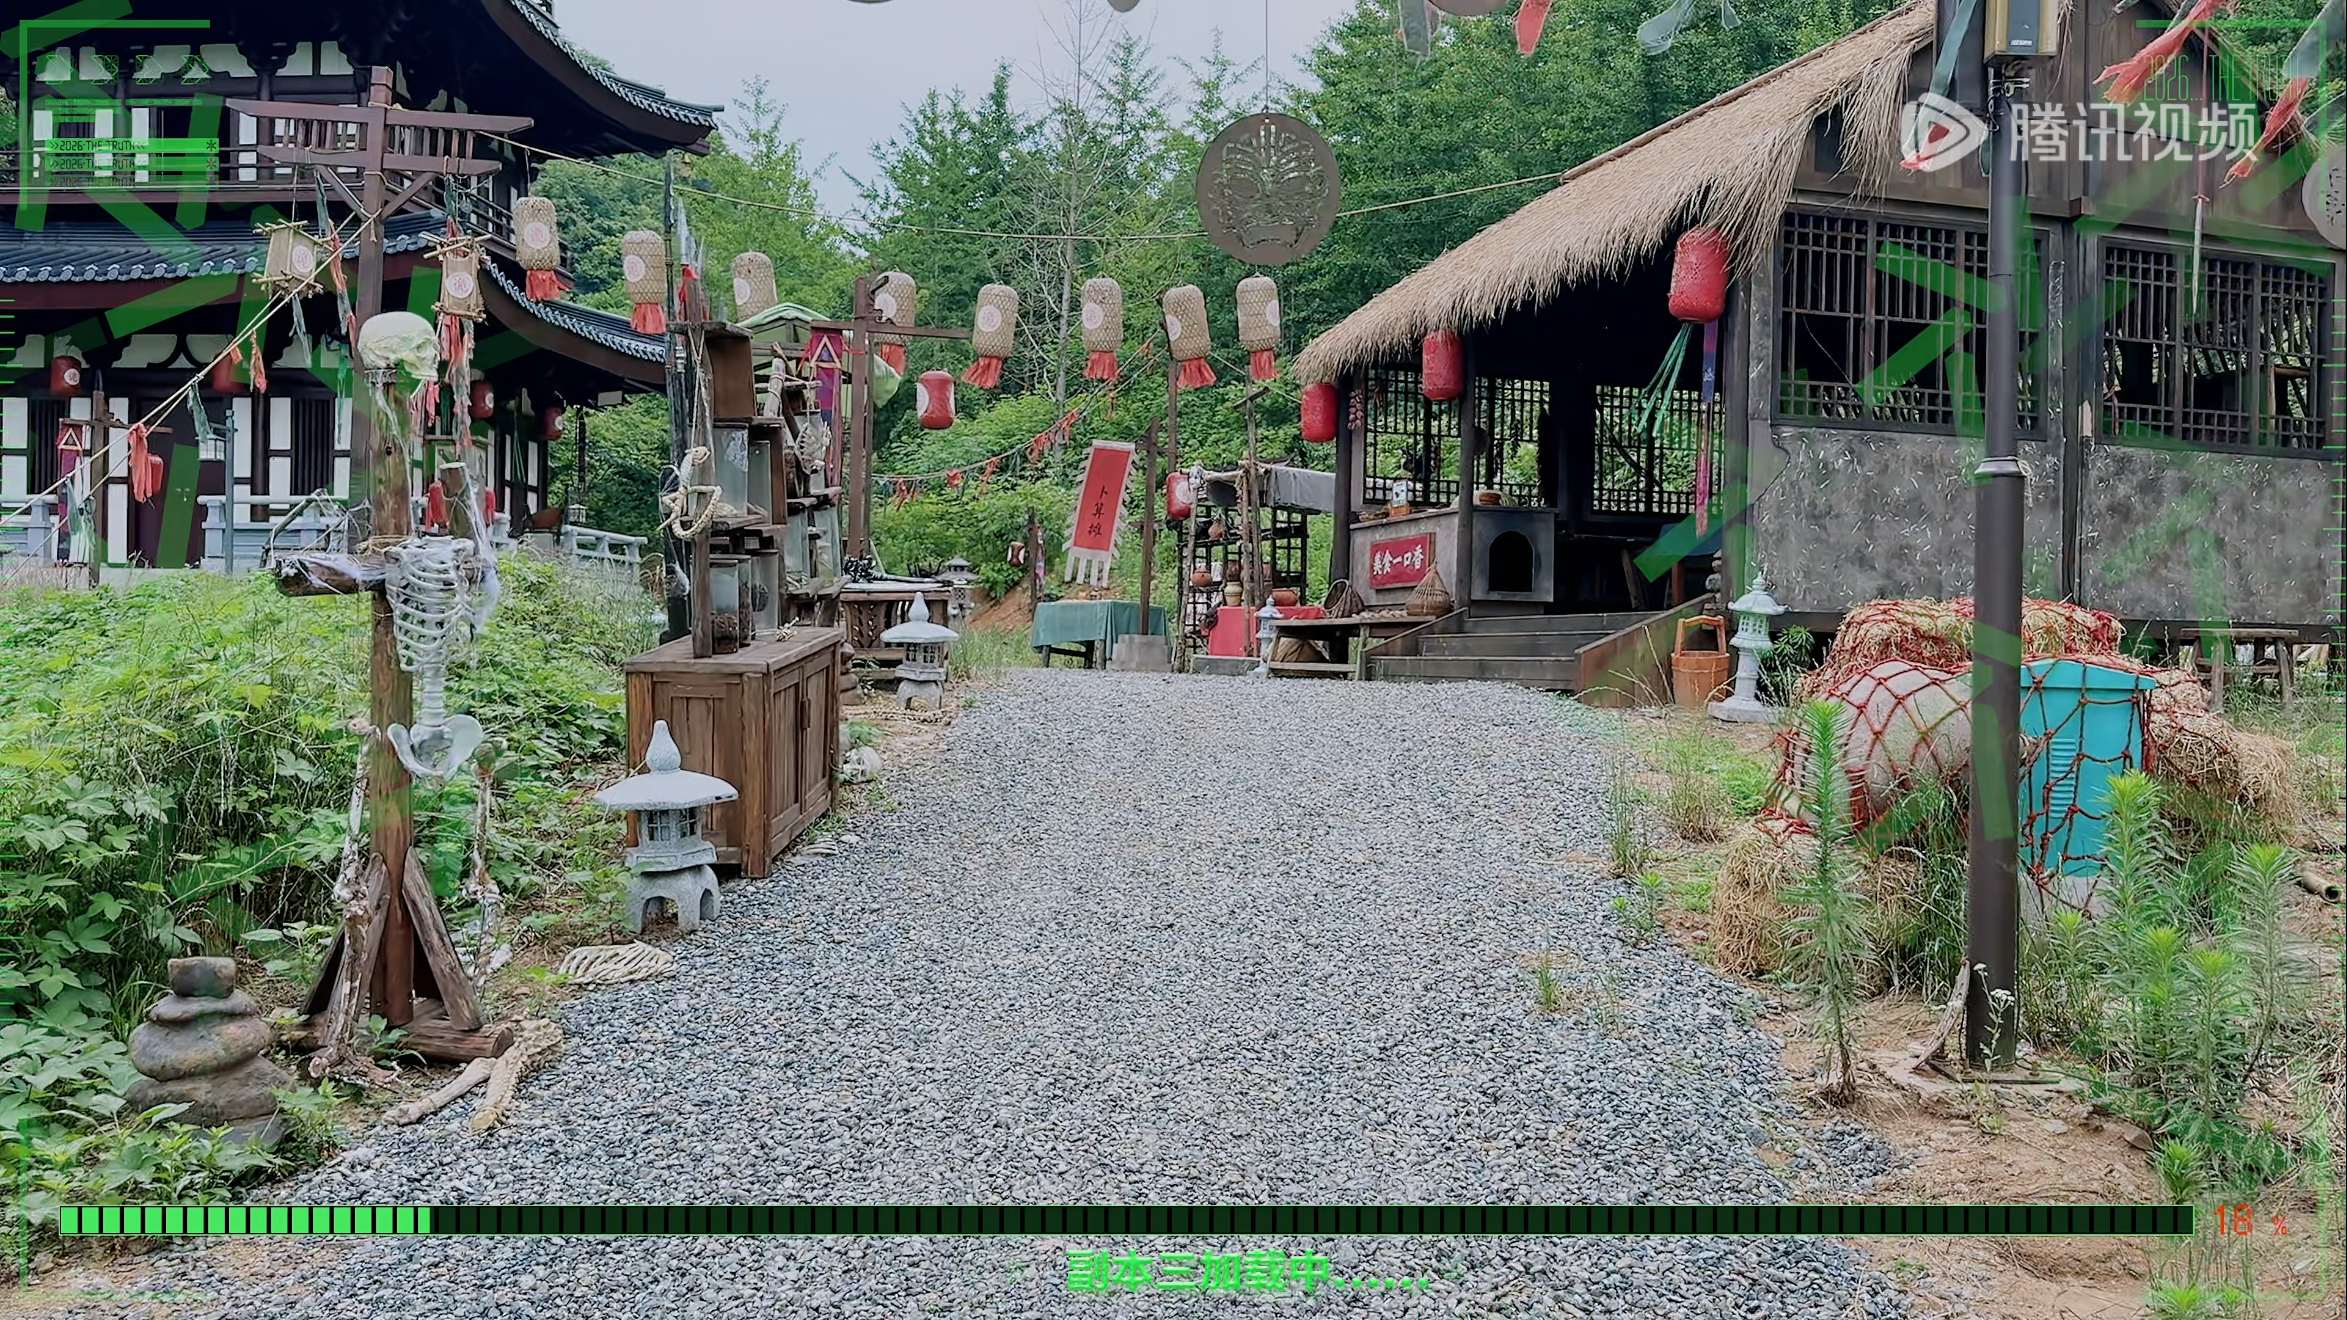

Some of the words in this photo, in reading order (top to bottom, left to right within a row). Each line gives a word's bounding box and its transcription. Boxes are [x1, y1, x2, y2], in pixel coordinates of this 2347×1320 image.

[1373, 543, 1424, 576] 美食一口香
